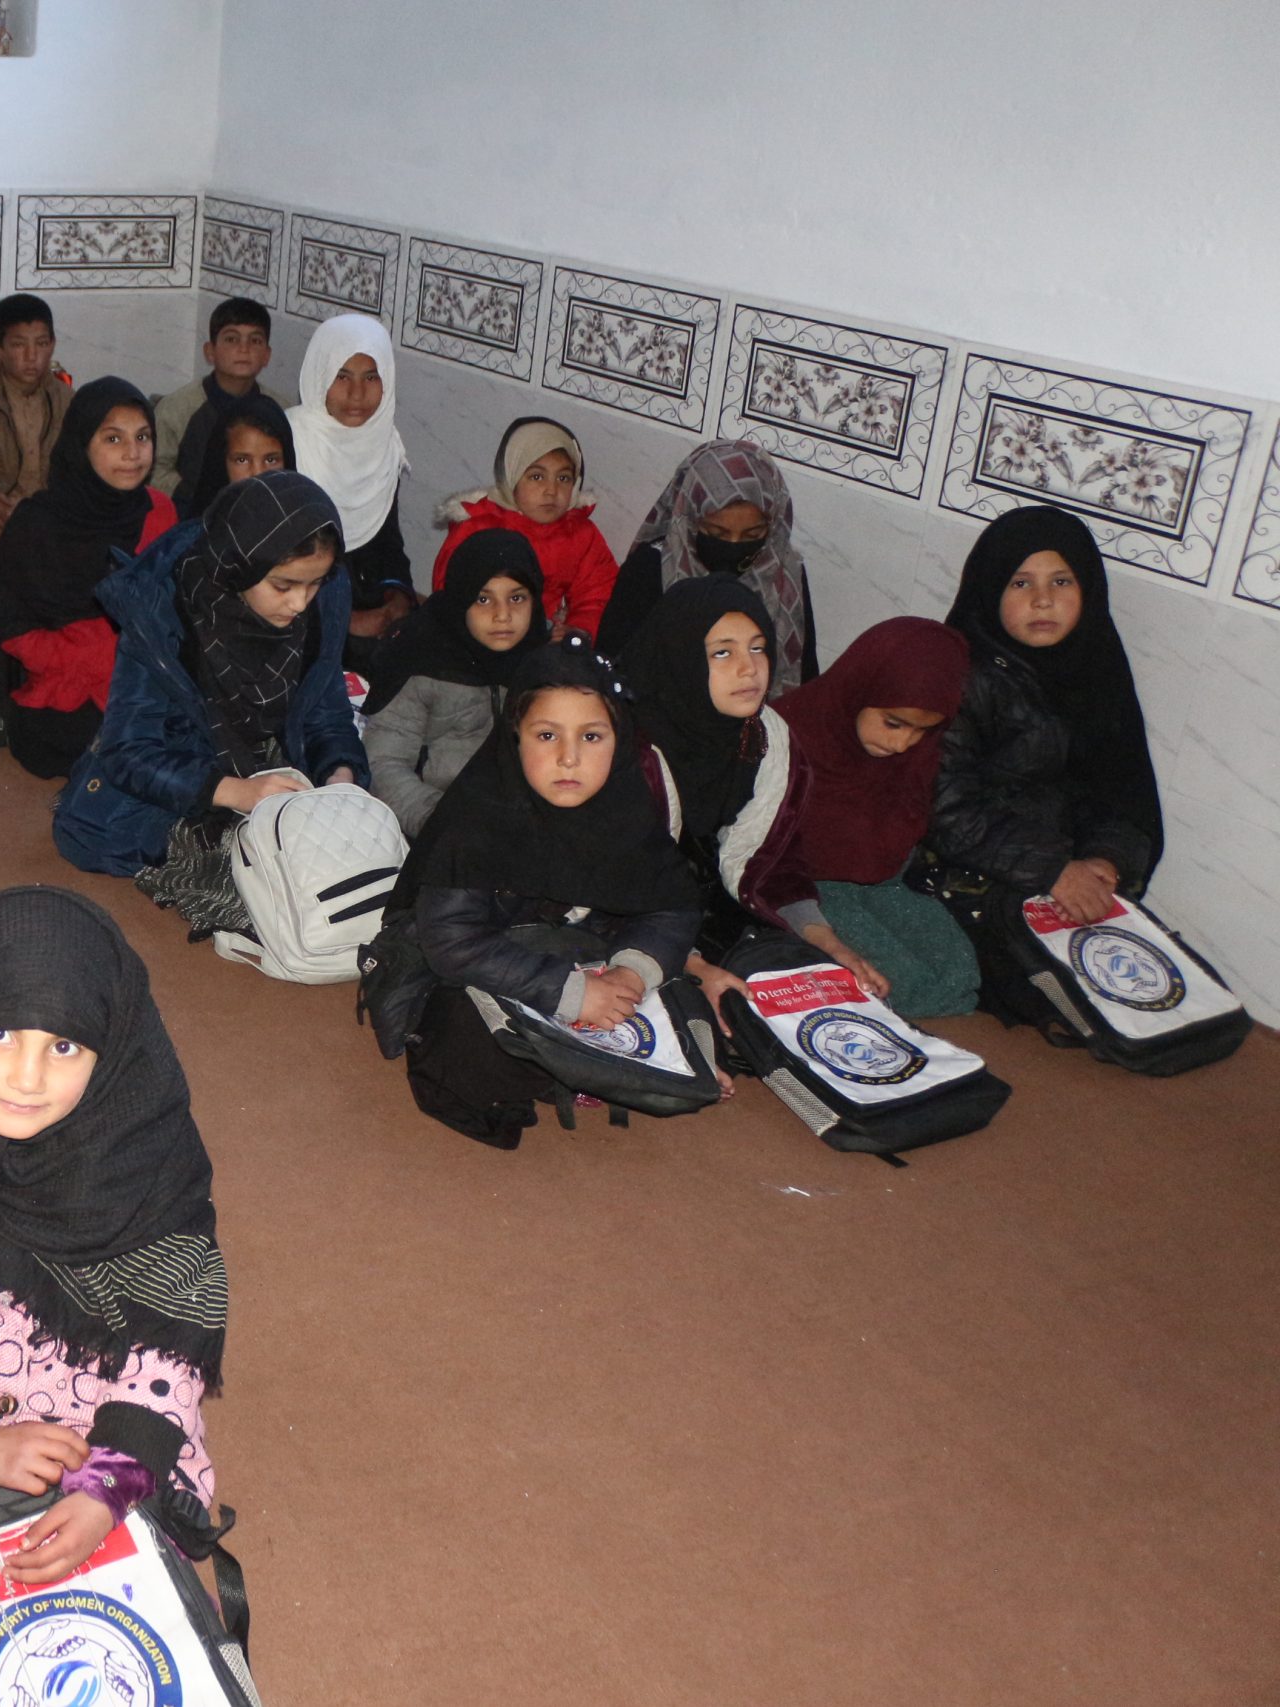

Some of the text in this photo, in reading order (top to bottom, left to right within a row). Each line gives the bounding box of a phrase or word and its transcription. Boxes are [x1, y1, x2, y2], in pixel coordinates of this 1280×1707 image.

[33, 1600, 50, 1613] OF
[53, 1597, 106, 1613] WOMEN
[106, 1605, 172, 1686] ORGANIZATION
